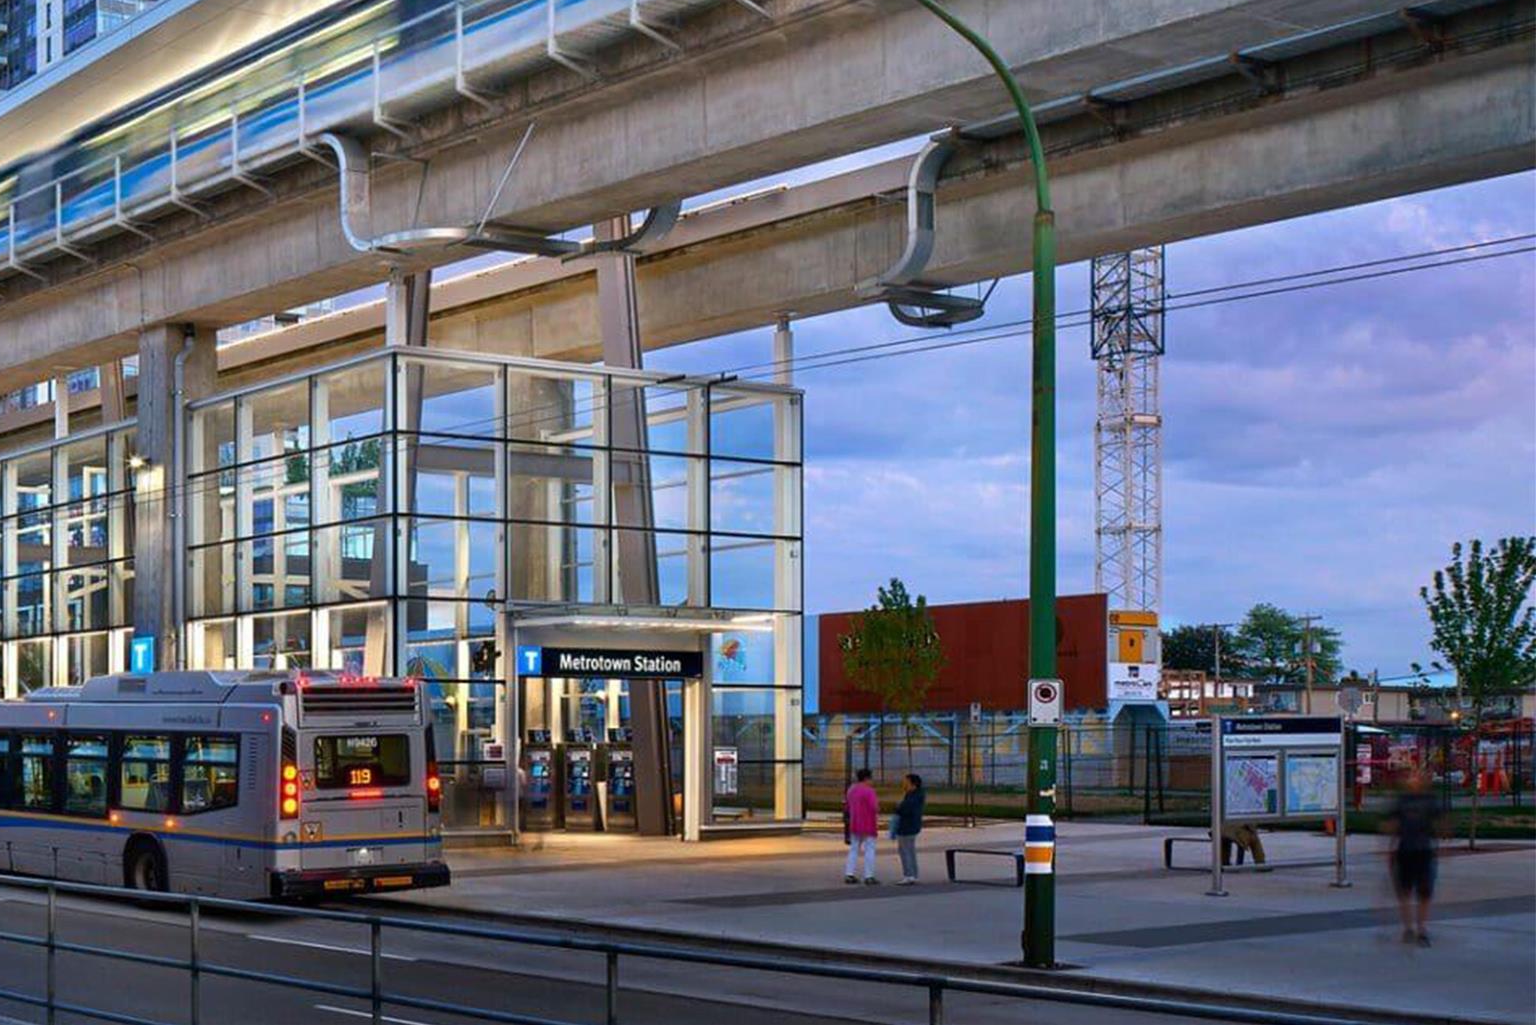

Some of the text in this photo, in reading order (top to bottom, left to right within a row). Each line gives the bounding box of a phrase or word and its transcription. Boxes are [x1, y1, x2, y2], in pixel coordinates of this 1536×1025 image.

[134, 644, 147, 671] T
[525, 651, 538, 671] T
[559, 653, 681, 672] Metrotown Station
[350, 769, 372, 784] 119
